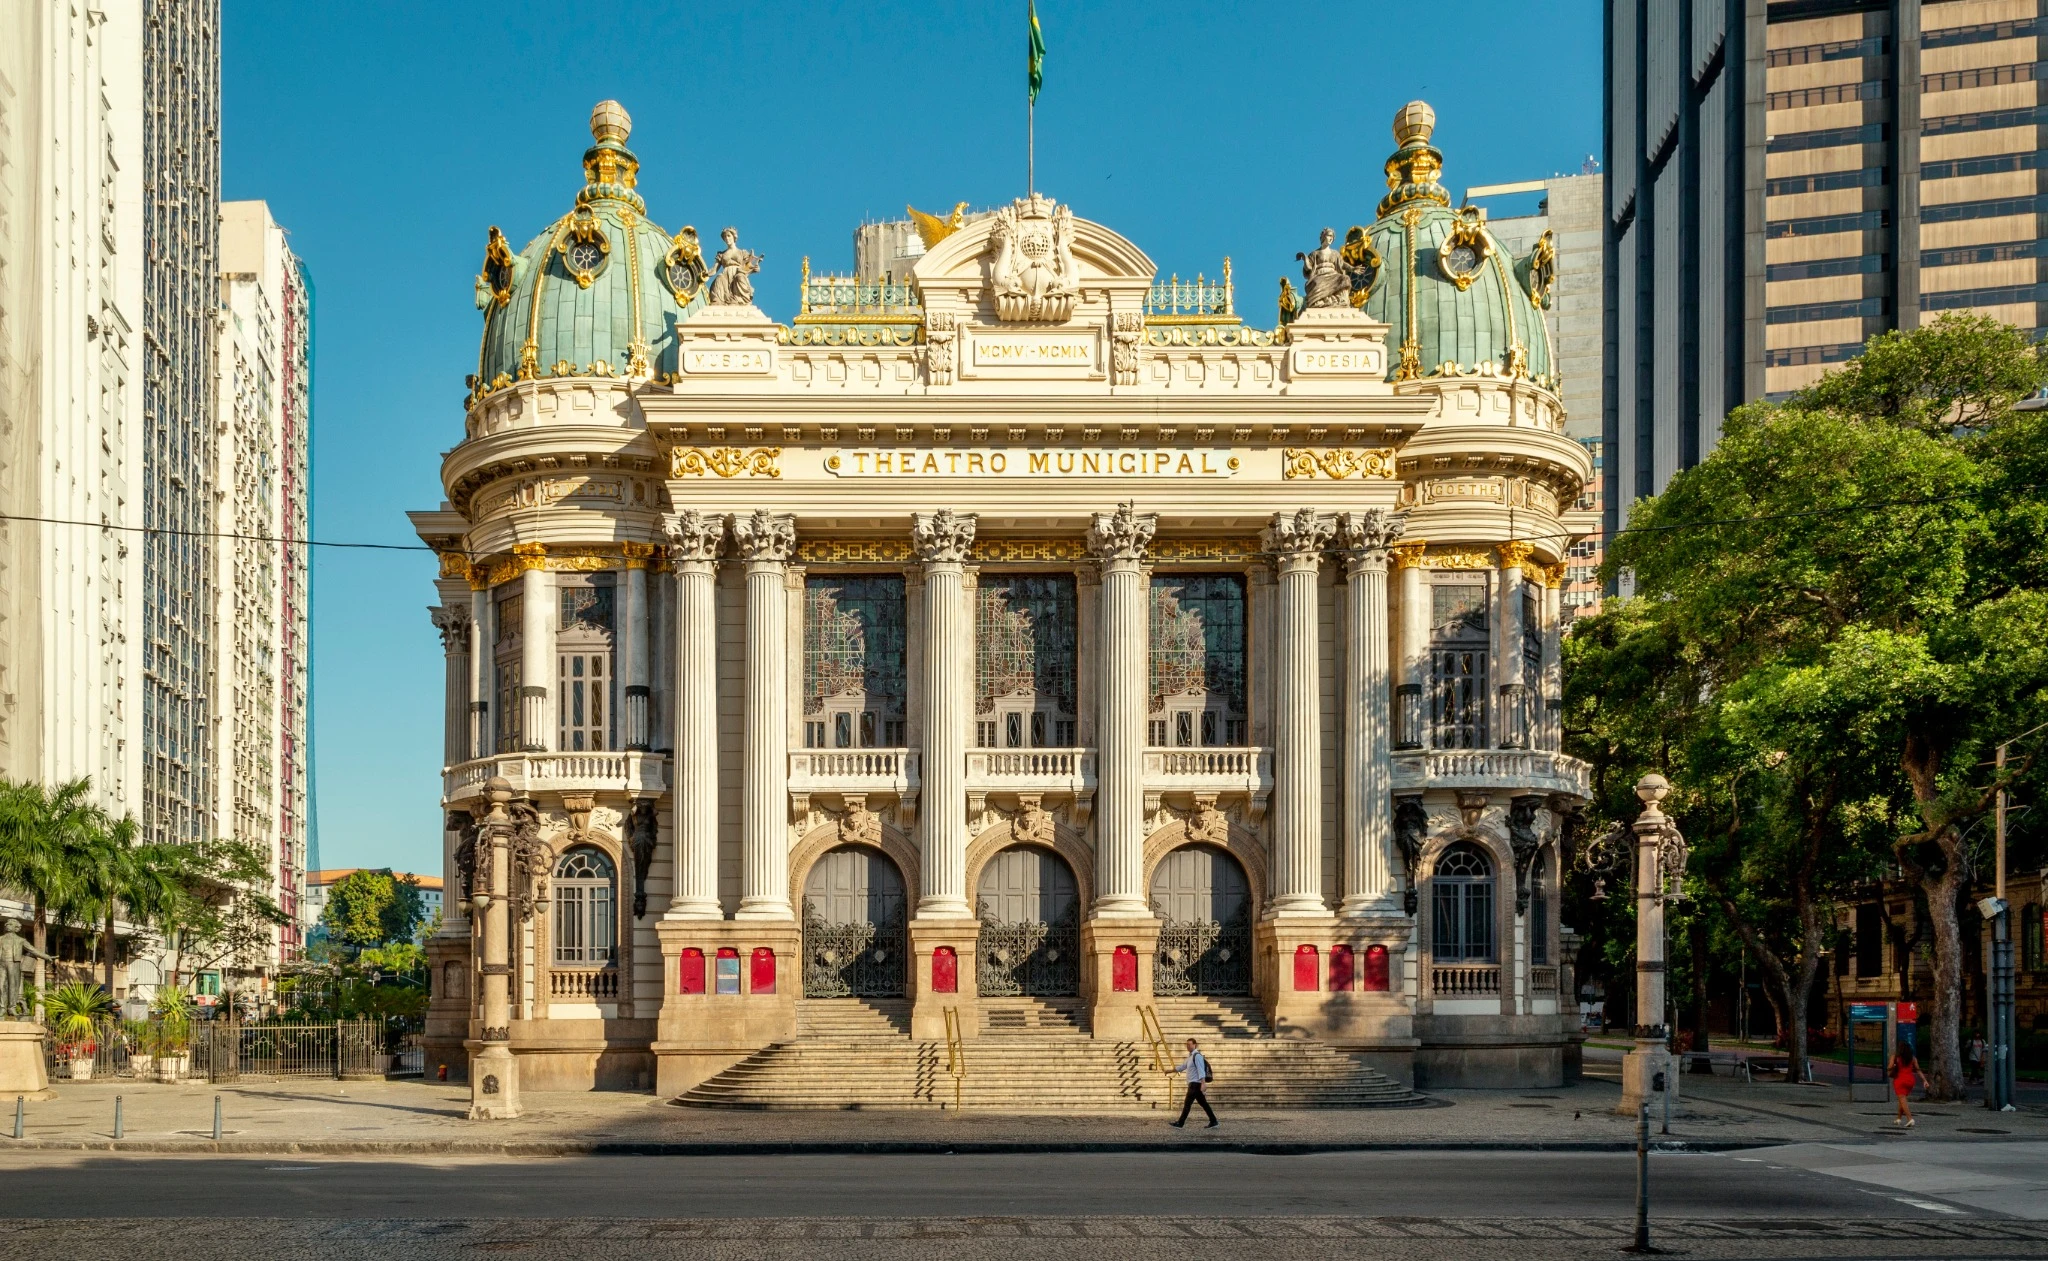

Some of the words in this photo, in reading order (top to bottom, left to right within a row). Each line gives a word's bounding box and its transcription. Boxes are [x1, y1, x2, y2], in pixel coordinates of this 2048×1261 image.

[1306, 354, 1371, 368] POESIA
[852, 452, 1007, 473] THEATRO
[1028, 452, 1217, 473] MUNICIPAL
